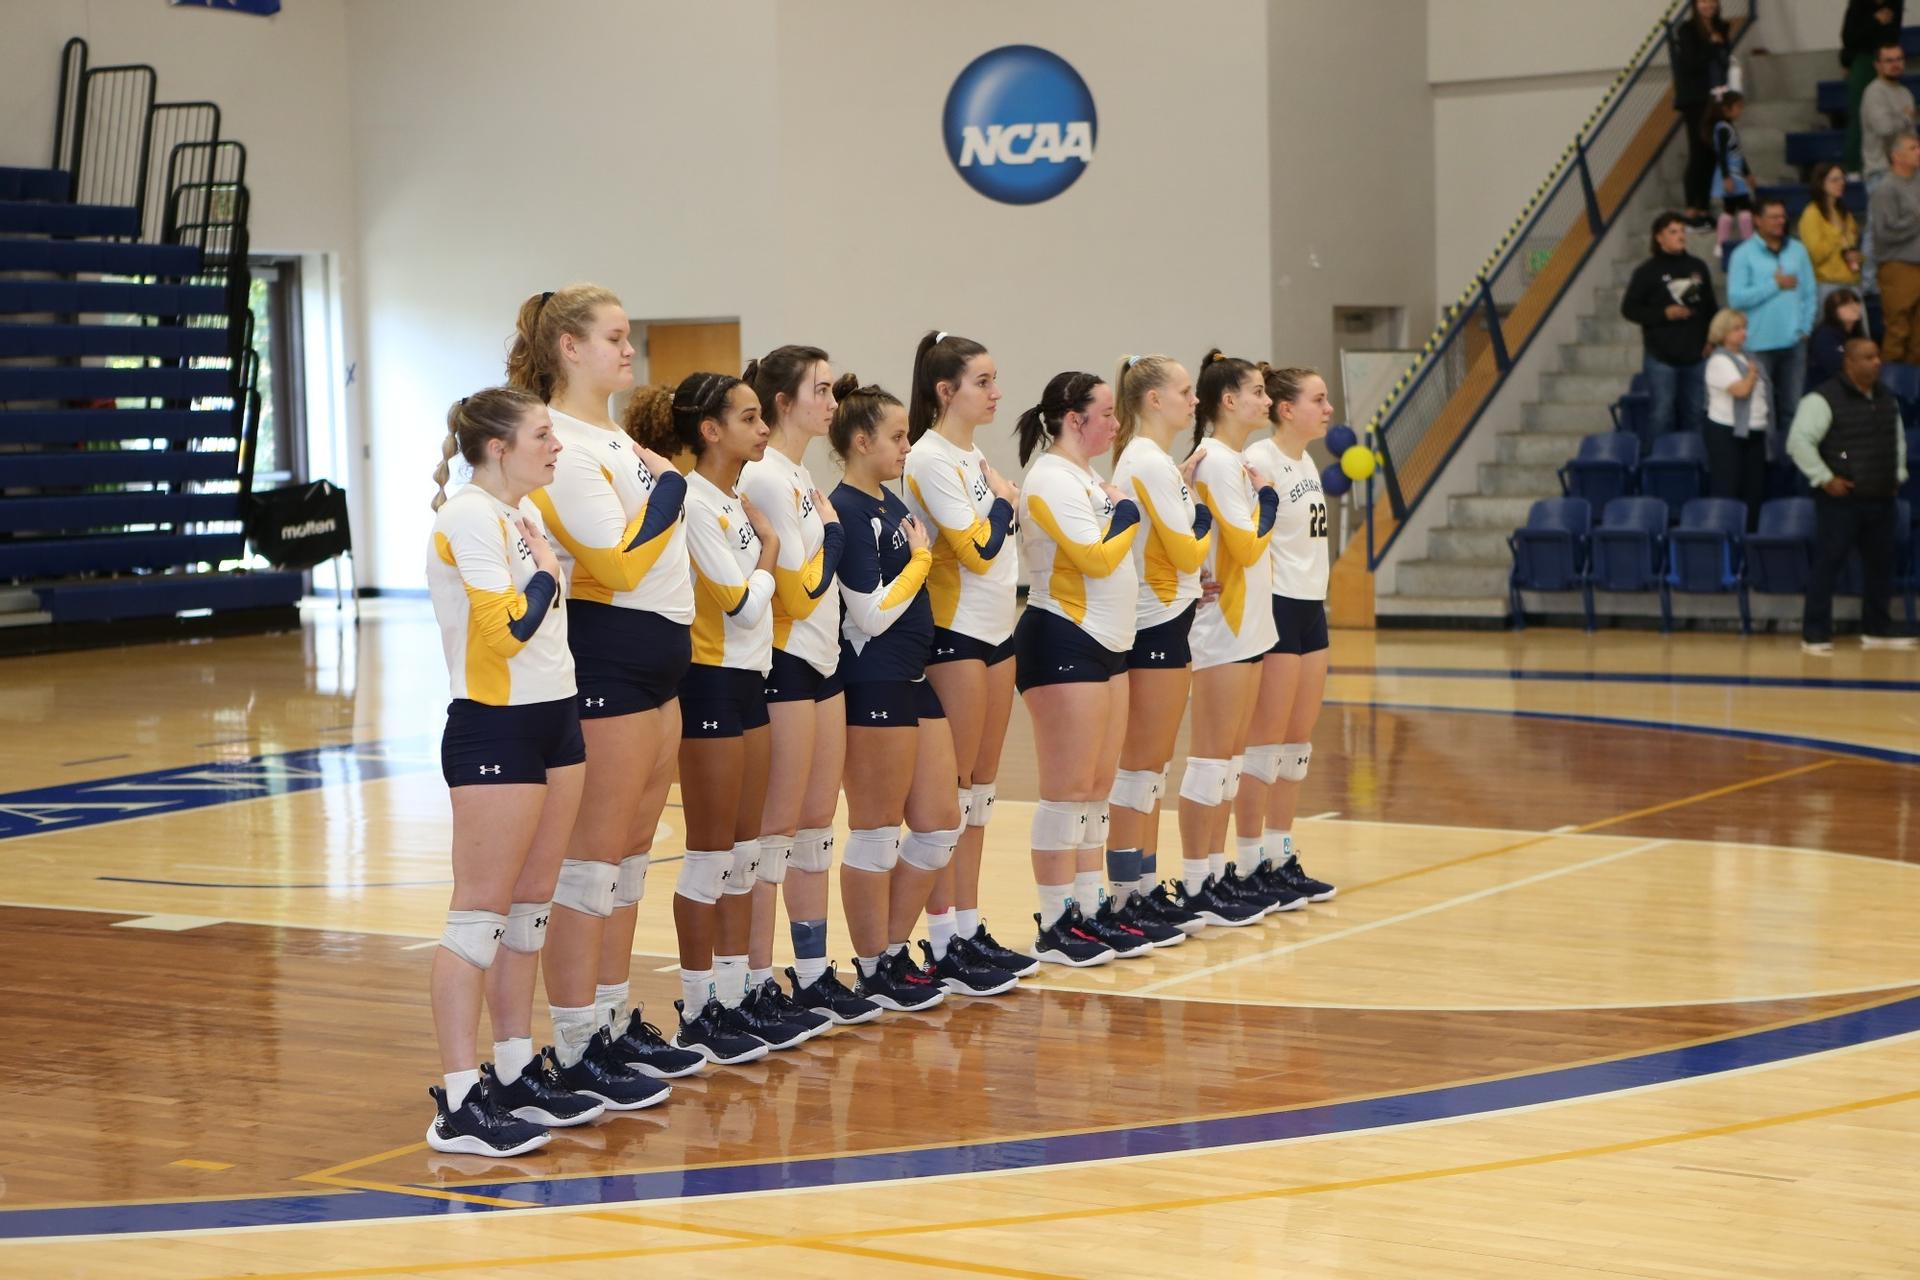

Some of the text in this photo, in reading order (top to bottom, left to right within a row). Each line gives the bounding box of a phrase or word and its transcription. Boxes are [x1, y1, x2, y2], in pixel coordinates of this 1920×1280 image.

[958, 121, 1093, 167] NCAA
[280, 518, 336, 540] molten
[1309, 503, 1328, 537] 22
